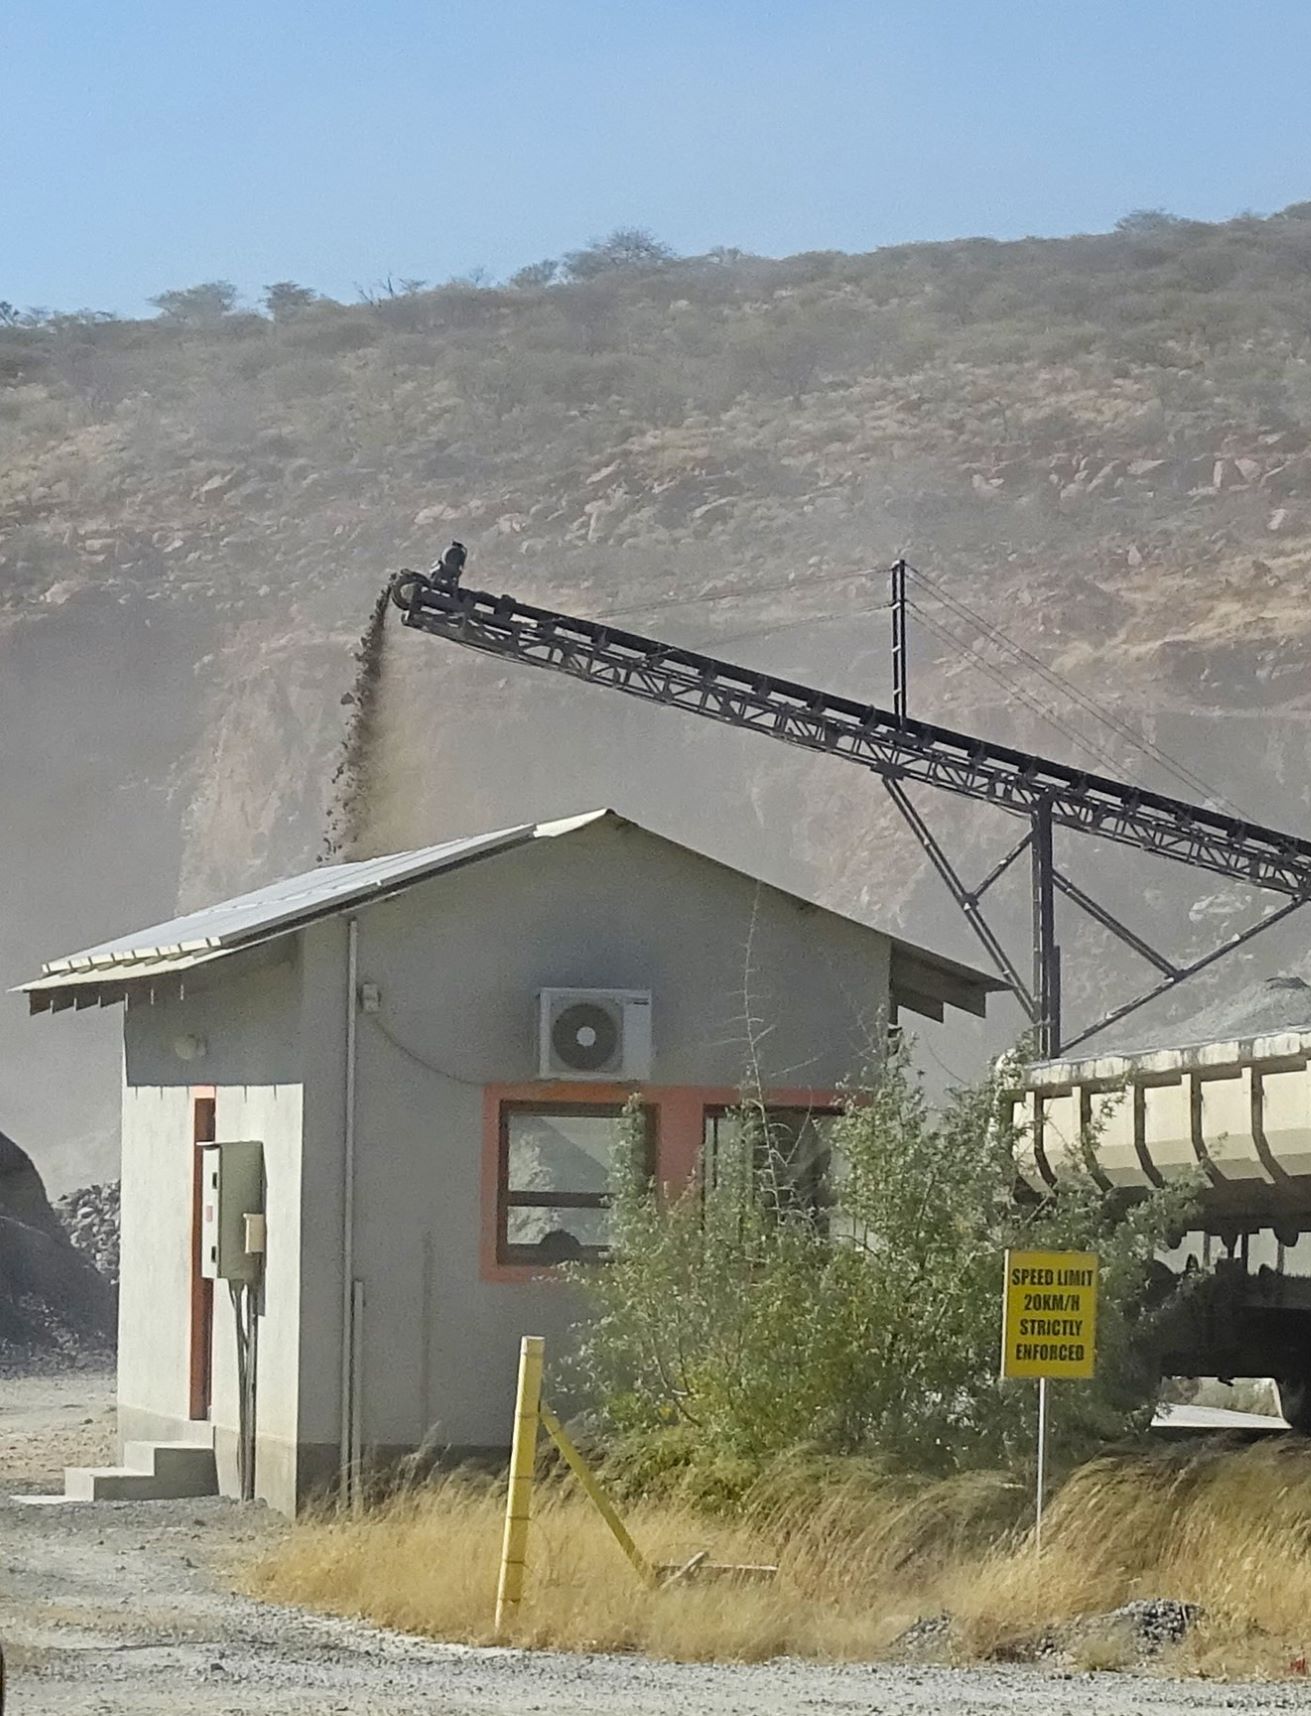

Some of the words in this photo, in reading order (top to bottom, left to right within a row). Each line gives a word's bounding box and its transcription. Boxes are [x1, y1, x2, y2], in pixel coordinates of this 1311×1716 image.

[1012, 1268, 1054, 1286] SPEED
[1057, 1269, 1093, 1287] LIMIT
[1023, 1293, 1080, 1311] 20KM/H
[1019, 1318, 1083, 1336] STRICTLY
[1015, 1344, 1085, 1361] ENFORCED
